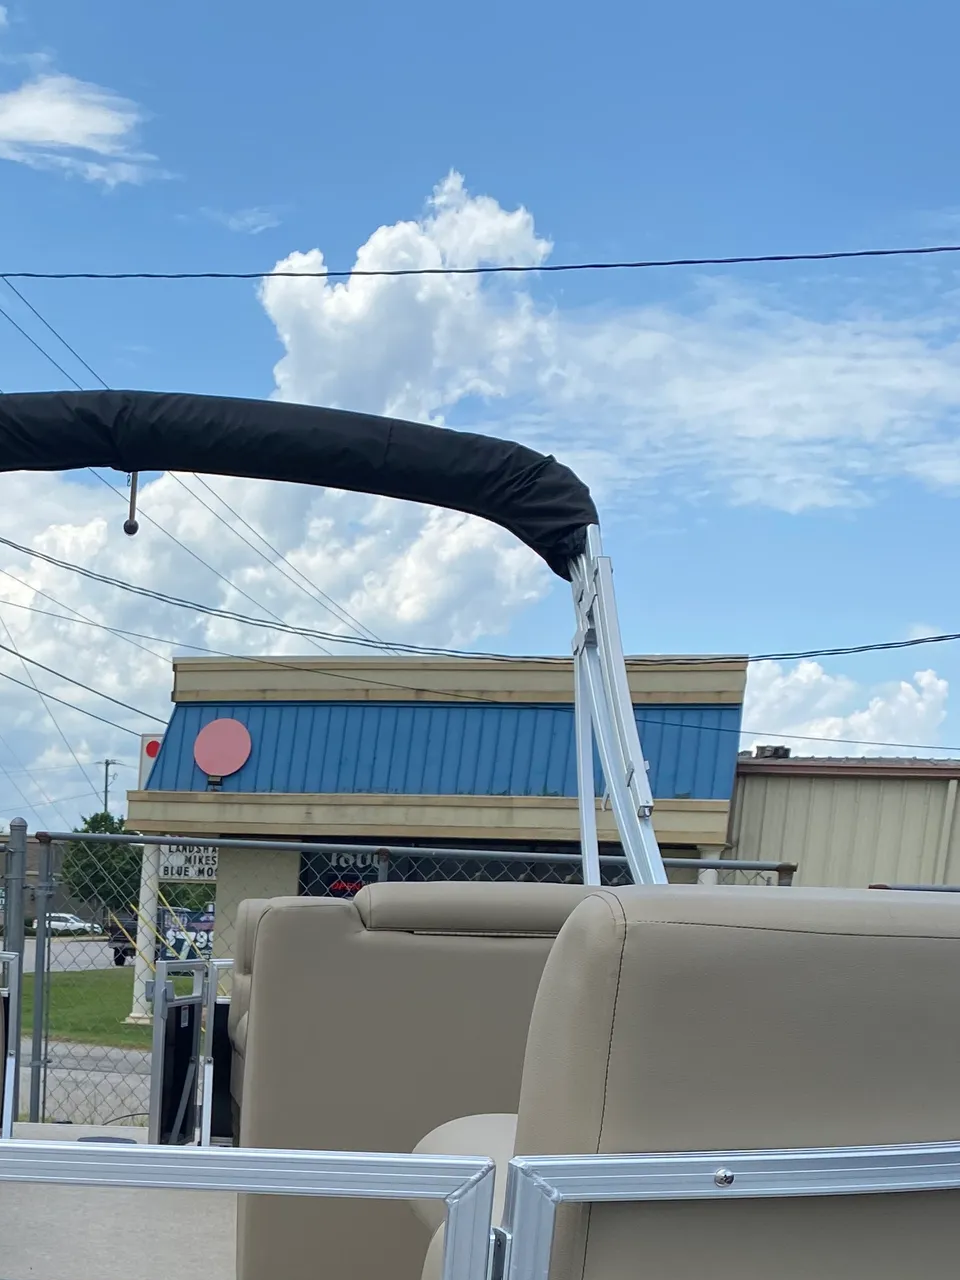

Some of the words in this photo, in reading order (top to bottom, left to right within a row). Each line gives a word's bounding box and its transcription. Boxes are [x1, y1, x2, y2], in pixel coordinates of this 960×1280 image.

[184, 855, 217, 866] MIKES
[163, 866, 190, 877] BLUE
[197, 867, 218, 877] MO
